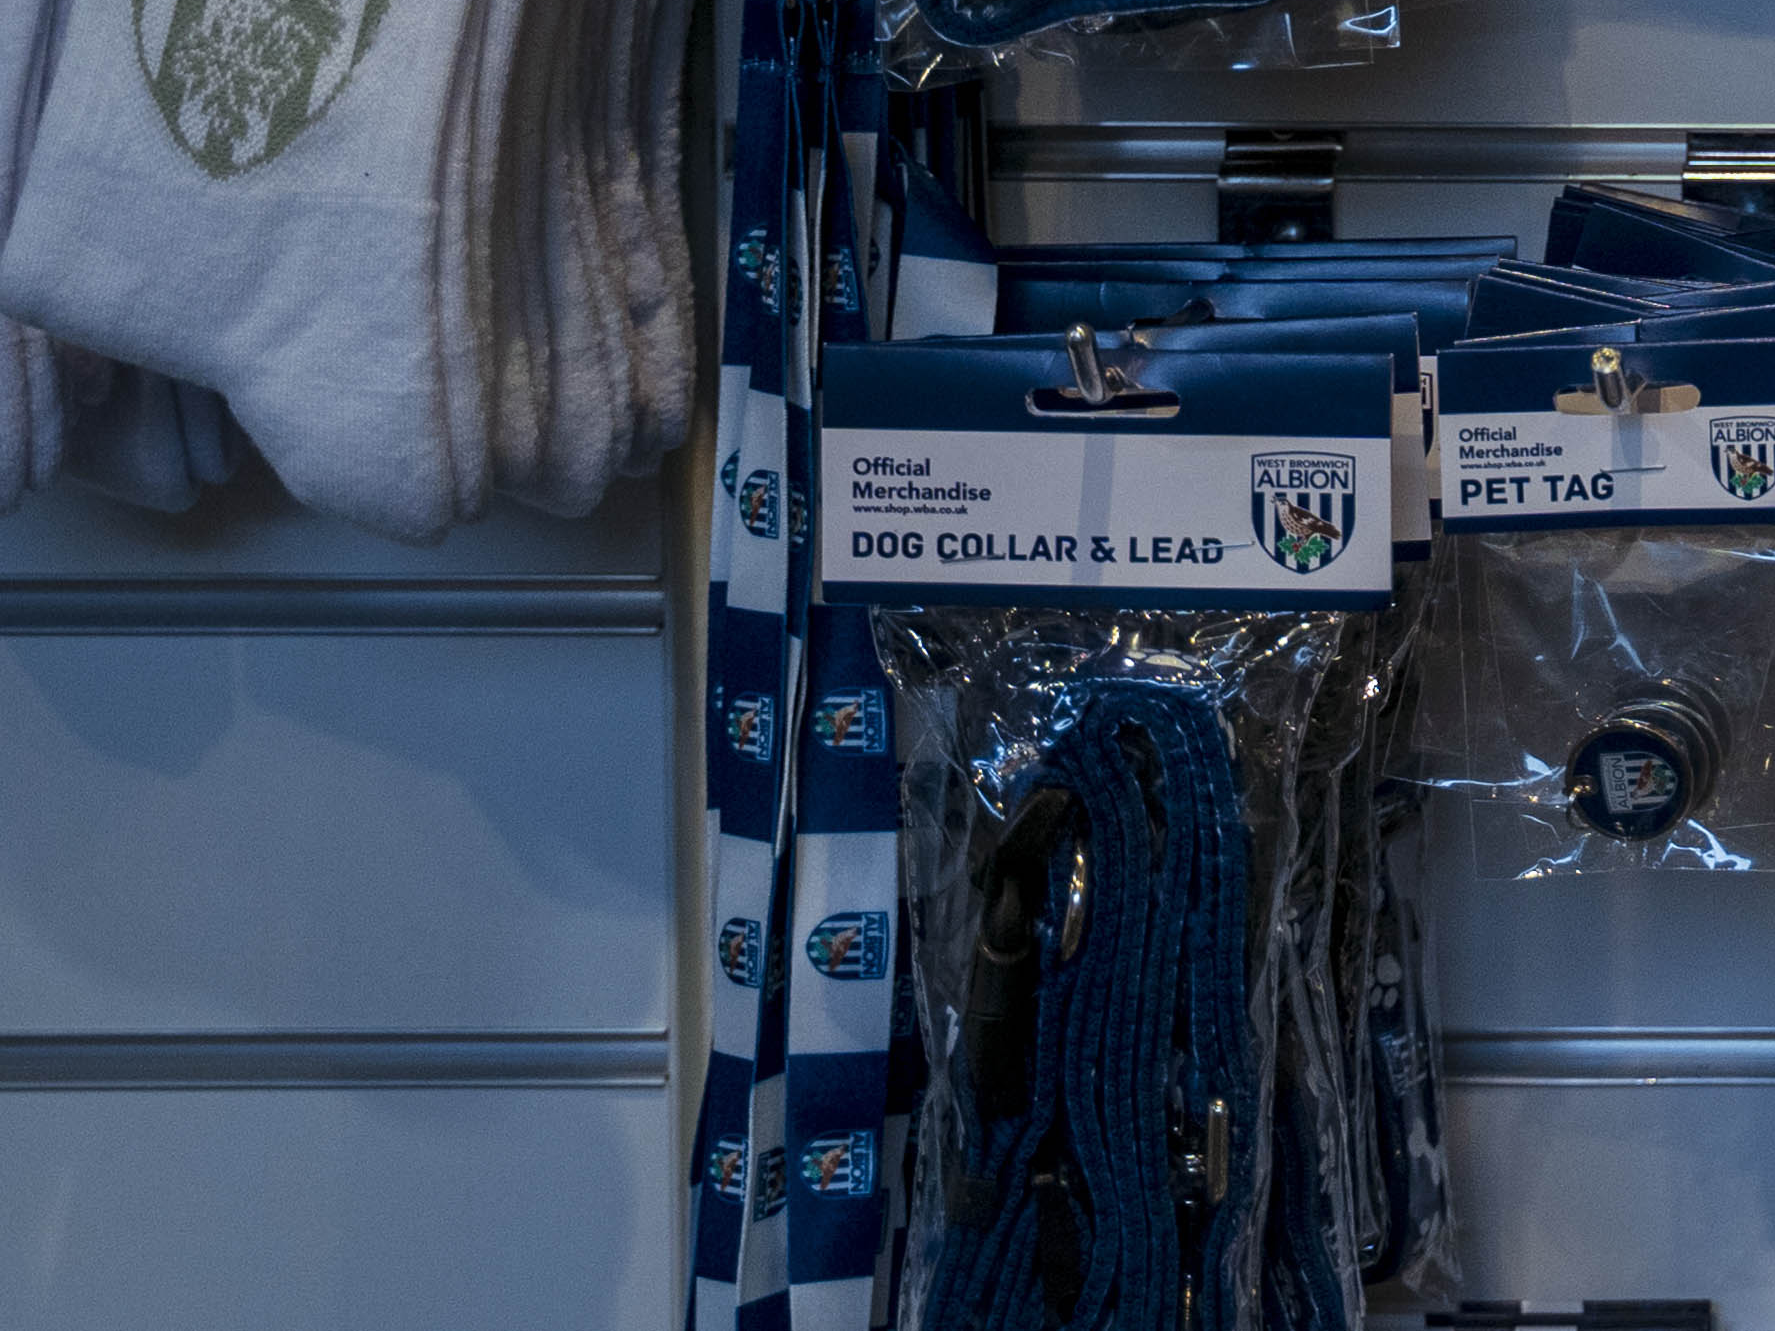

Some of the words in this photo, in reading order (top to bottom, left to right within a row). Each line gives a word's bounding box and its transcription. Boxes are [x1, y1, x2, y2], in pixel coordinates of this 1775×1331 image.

[1459, 426, 1517, 443] Official
[1459, 443, 1563, 459] Merchandise
[853, 457, 931, 477] Official
[1257, 469, 1350, 489] ALBION
[1460, 476, 1530, 505] PET
[1543, 473, 1614, 502] TAG
[852, 481, 992, 501] Merchandise
[853, 504, 968, 516] www.shop.wba.co.uk
[852, 532, 923, 558] DOG
[936, 533, 1078, 562] COLLAR
[1091, 536, 1117, 562] &
[1129, 537, 1224, 564] LEAD
